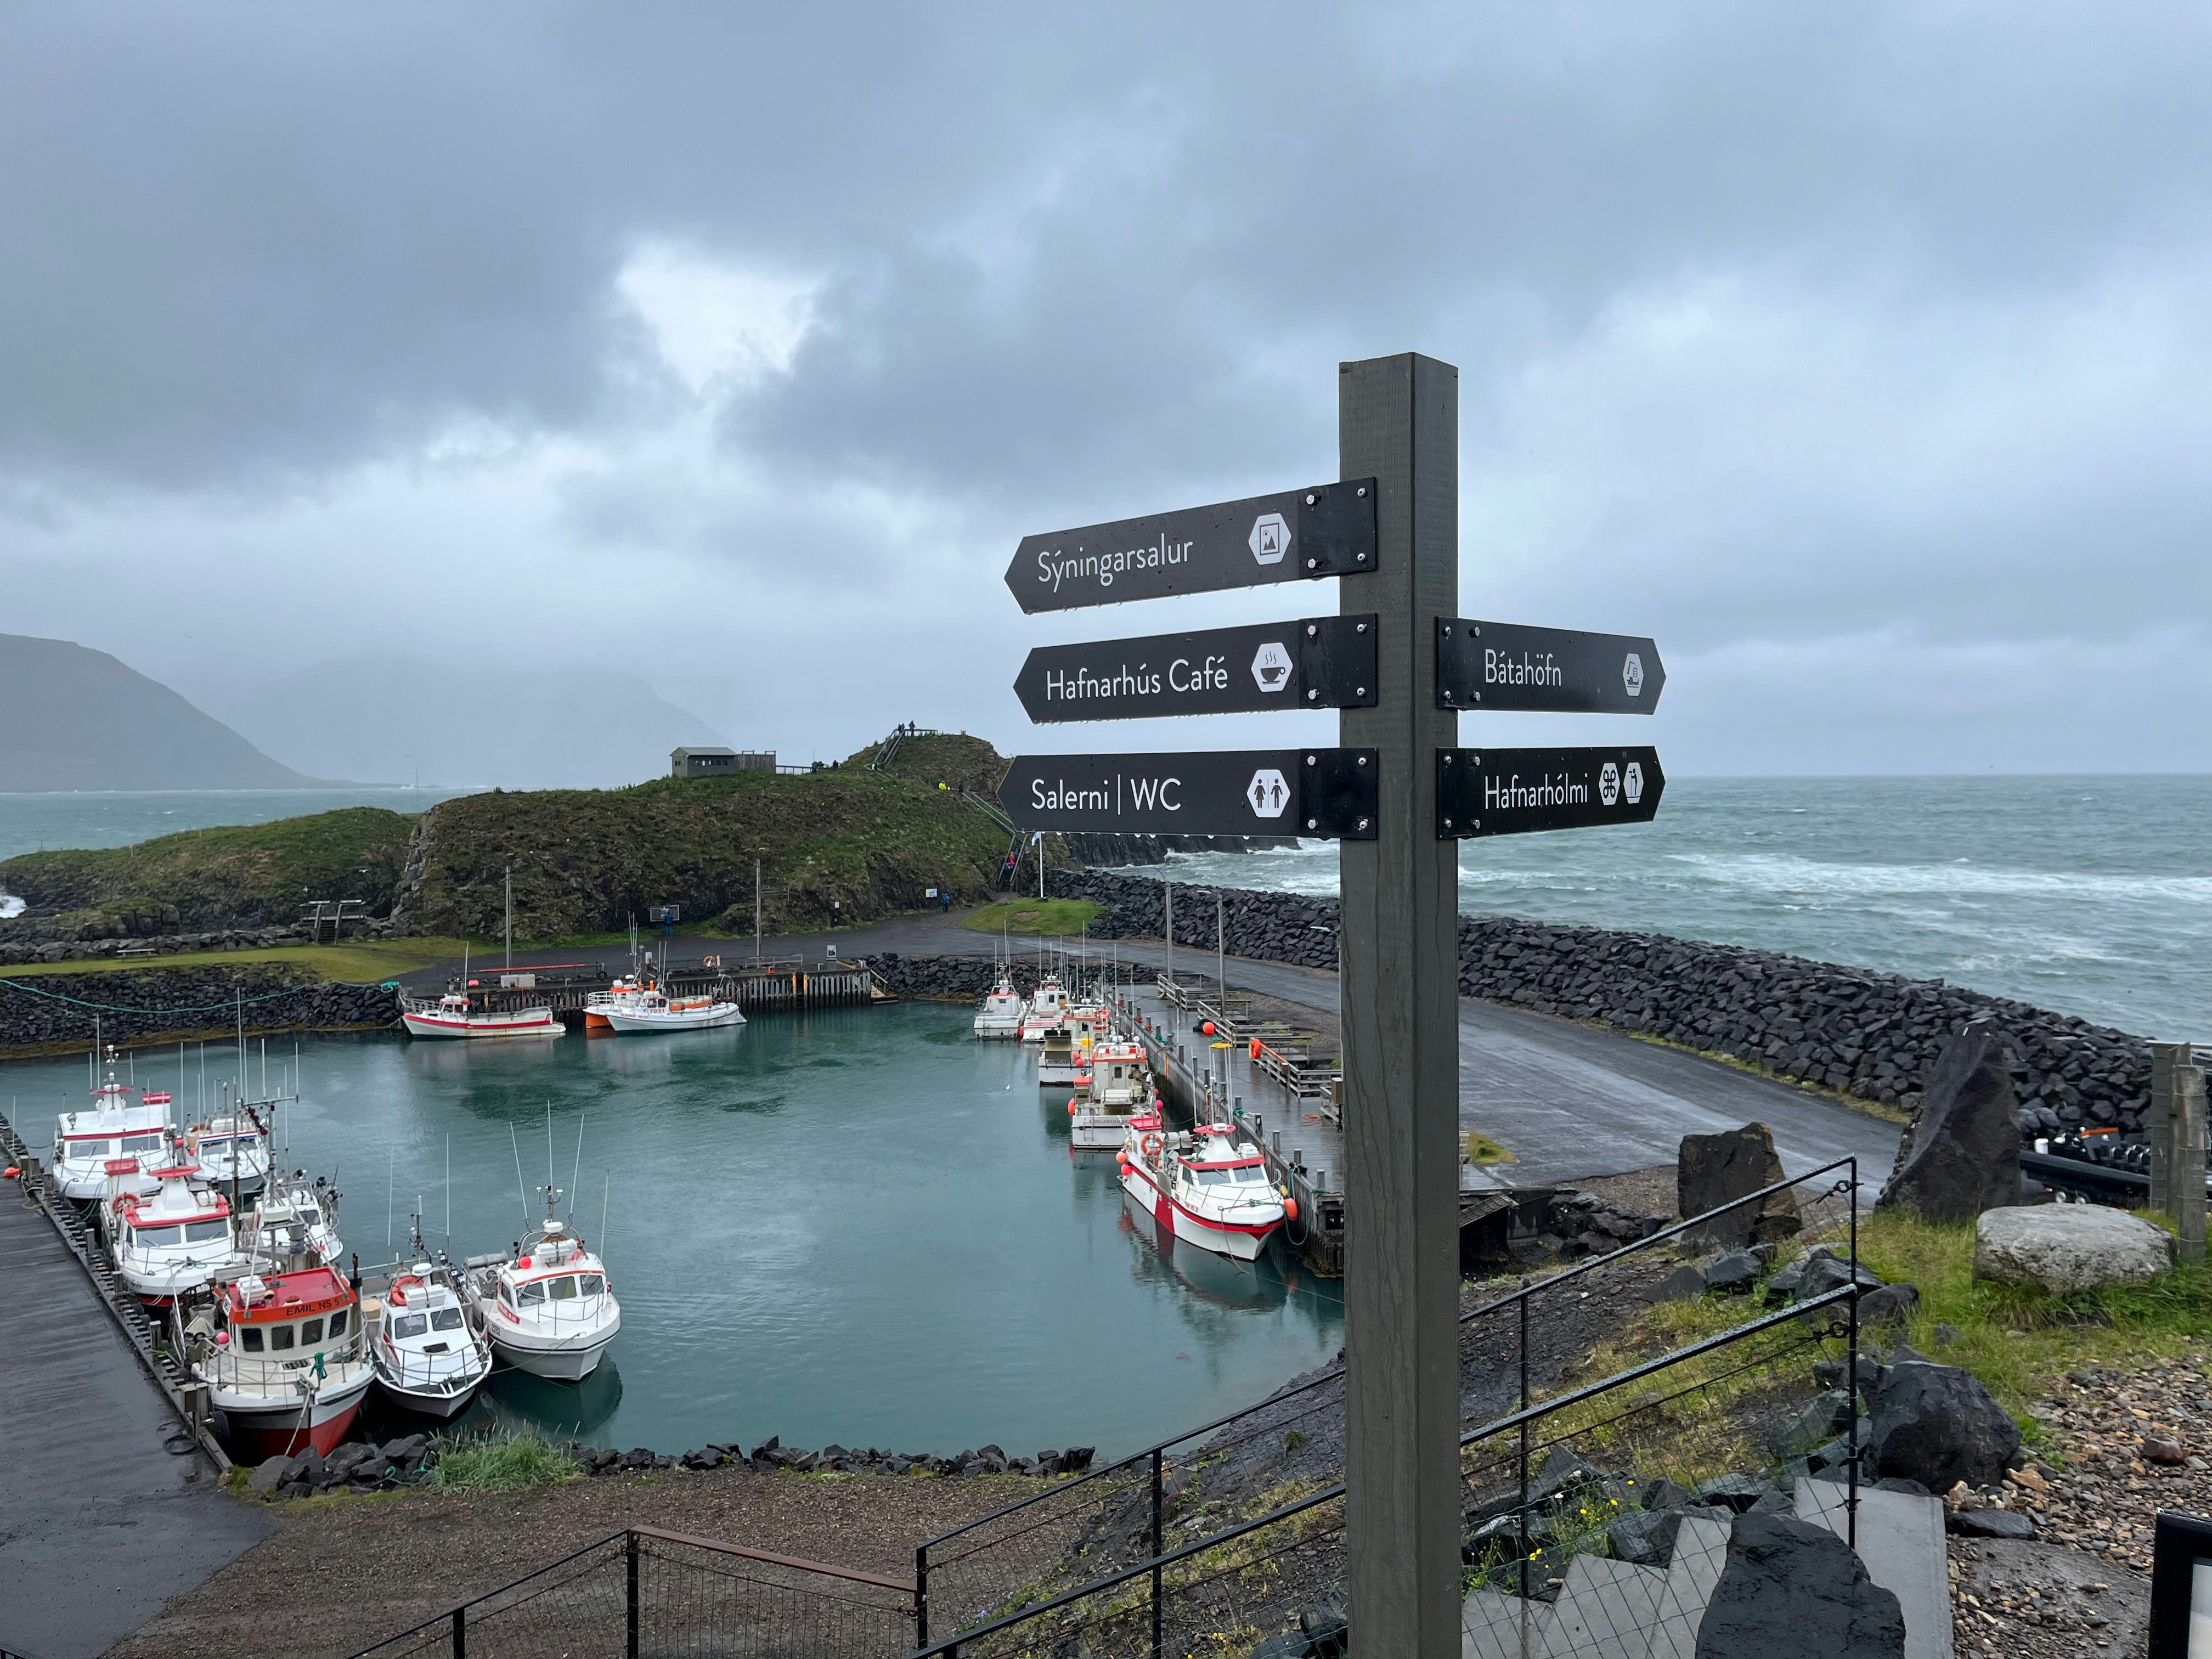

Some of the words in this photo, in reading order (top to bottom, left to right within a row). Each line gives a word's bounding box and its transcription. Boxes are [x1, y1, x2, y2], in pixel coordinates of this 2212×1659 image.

[1037, 533, 1194, 592] Sýningarsalur
[1046, 663, 1161, 701] Hafnarhús
[1169, 656, 1228, 692] Café
[1485, 648, 1562, 686] Bátahöfn
[1031, 778, 1109, 810] Salerni
[1130, 778, 1182, 811] WC
[1485, 773, 1588, 810] Hafnarhólmi
[286, 1304, 315, 1316] EMIL
[319, 1300, 332, 1310] NS
